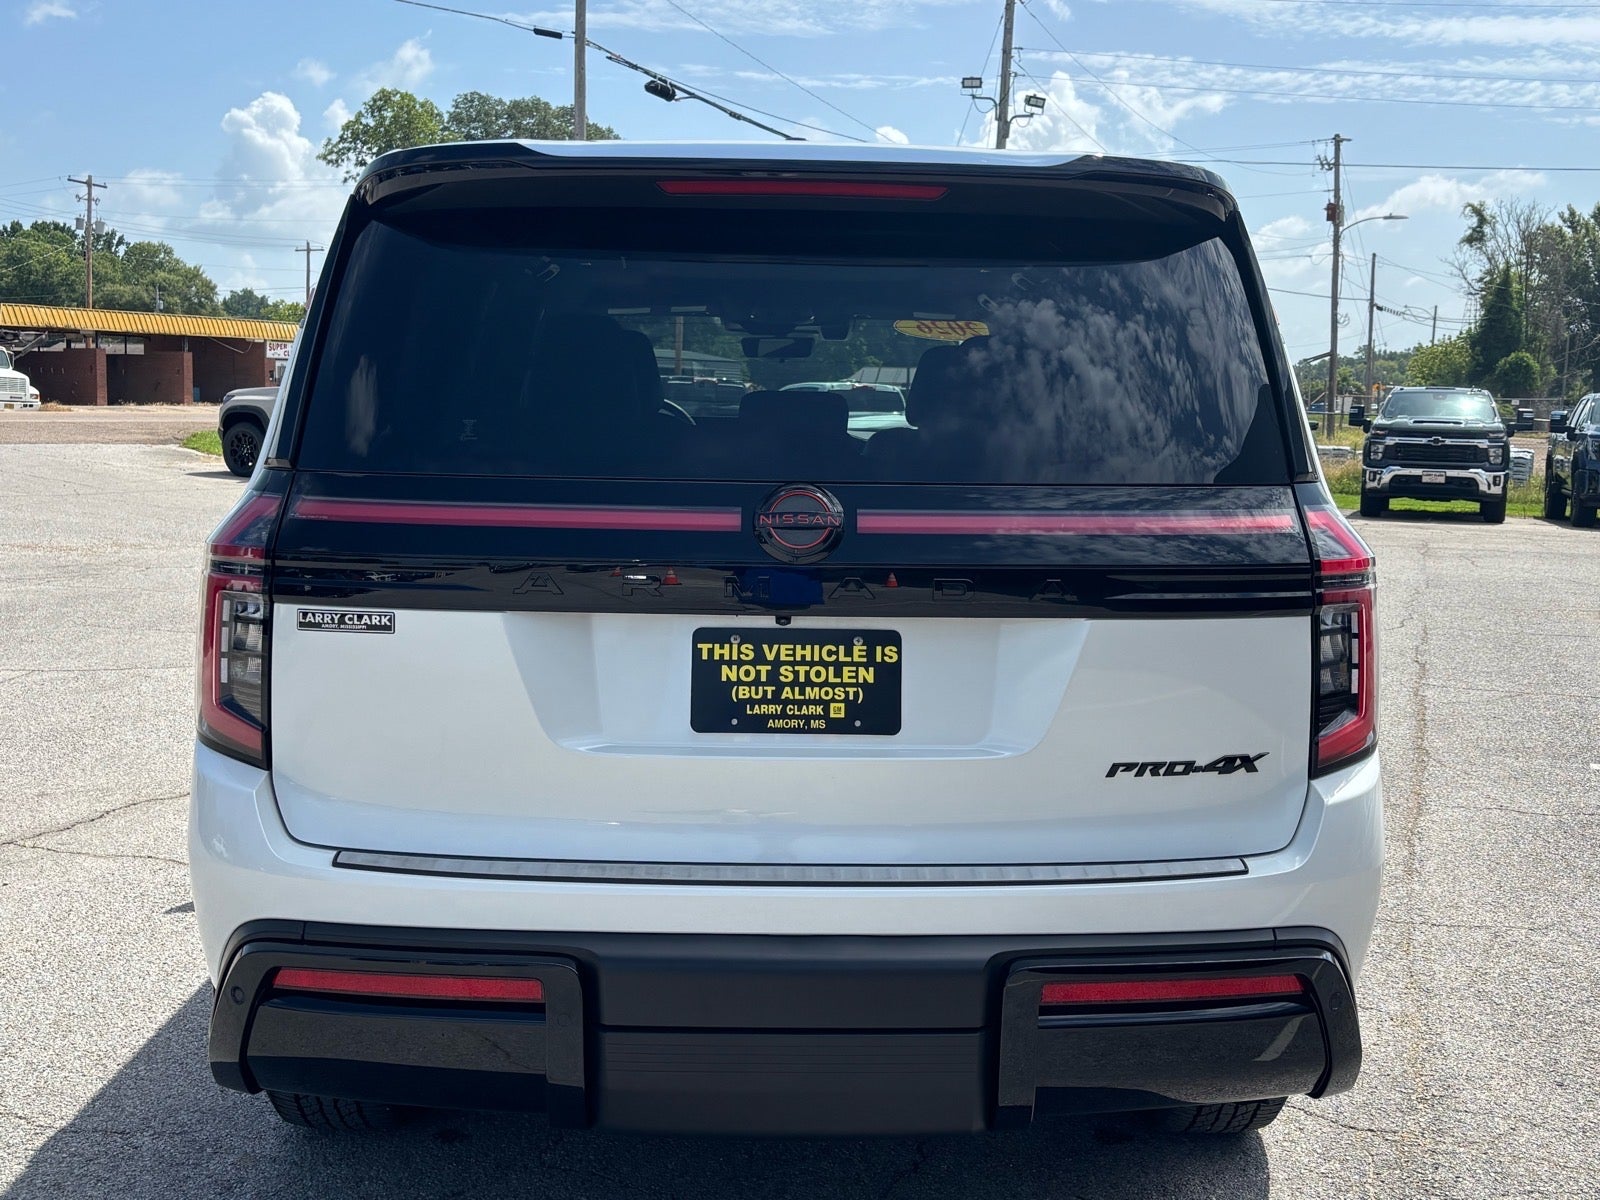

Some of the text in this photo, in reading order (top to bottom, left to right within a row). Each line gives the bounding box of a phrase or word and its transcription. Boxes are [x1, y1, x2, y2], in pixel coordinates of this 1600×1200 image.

[269, 343, 287, 351] SUPER
[760, 514, 839, 526] NISSAN
[513, 571, 1079, 600] ARMADA
[300, 612, 391, 626] LARRY CLARK
[698, 643, 899, 663] THIS VEHICLE IS
[721, 665, 874, 683] NOT STOLEN
[731, 685, 864, 704] (BUT ALMOST)
[746, 704, 824, 716] LARRY CLARK
[767, 719, 826, 730] AMORY, MS
[1105, 752, 1270, 778] PRO-4X
